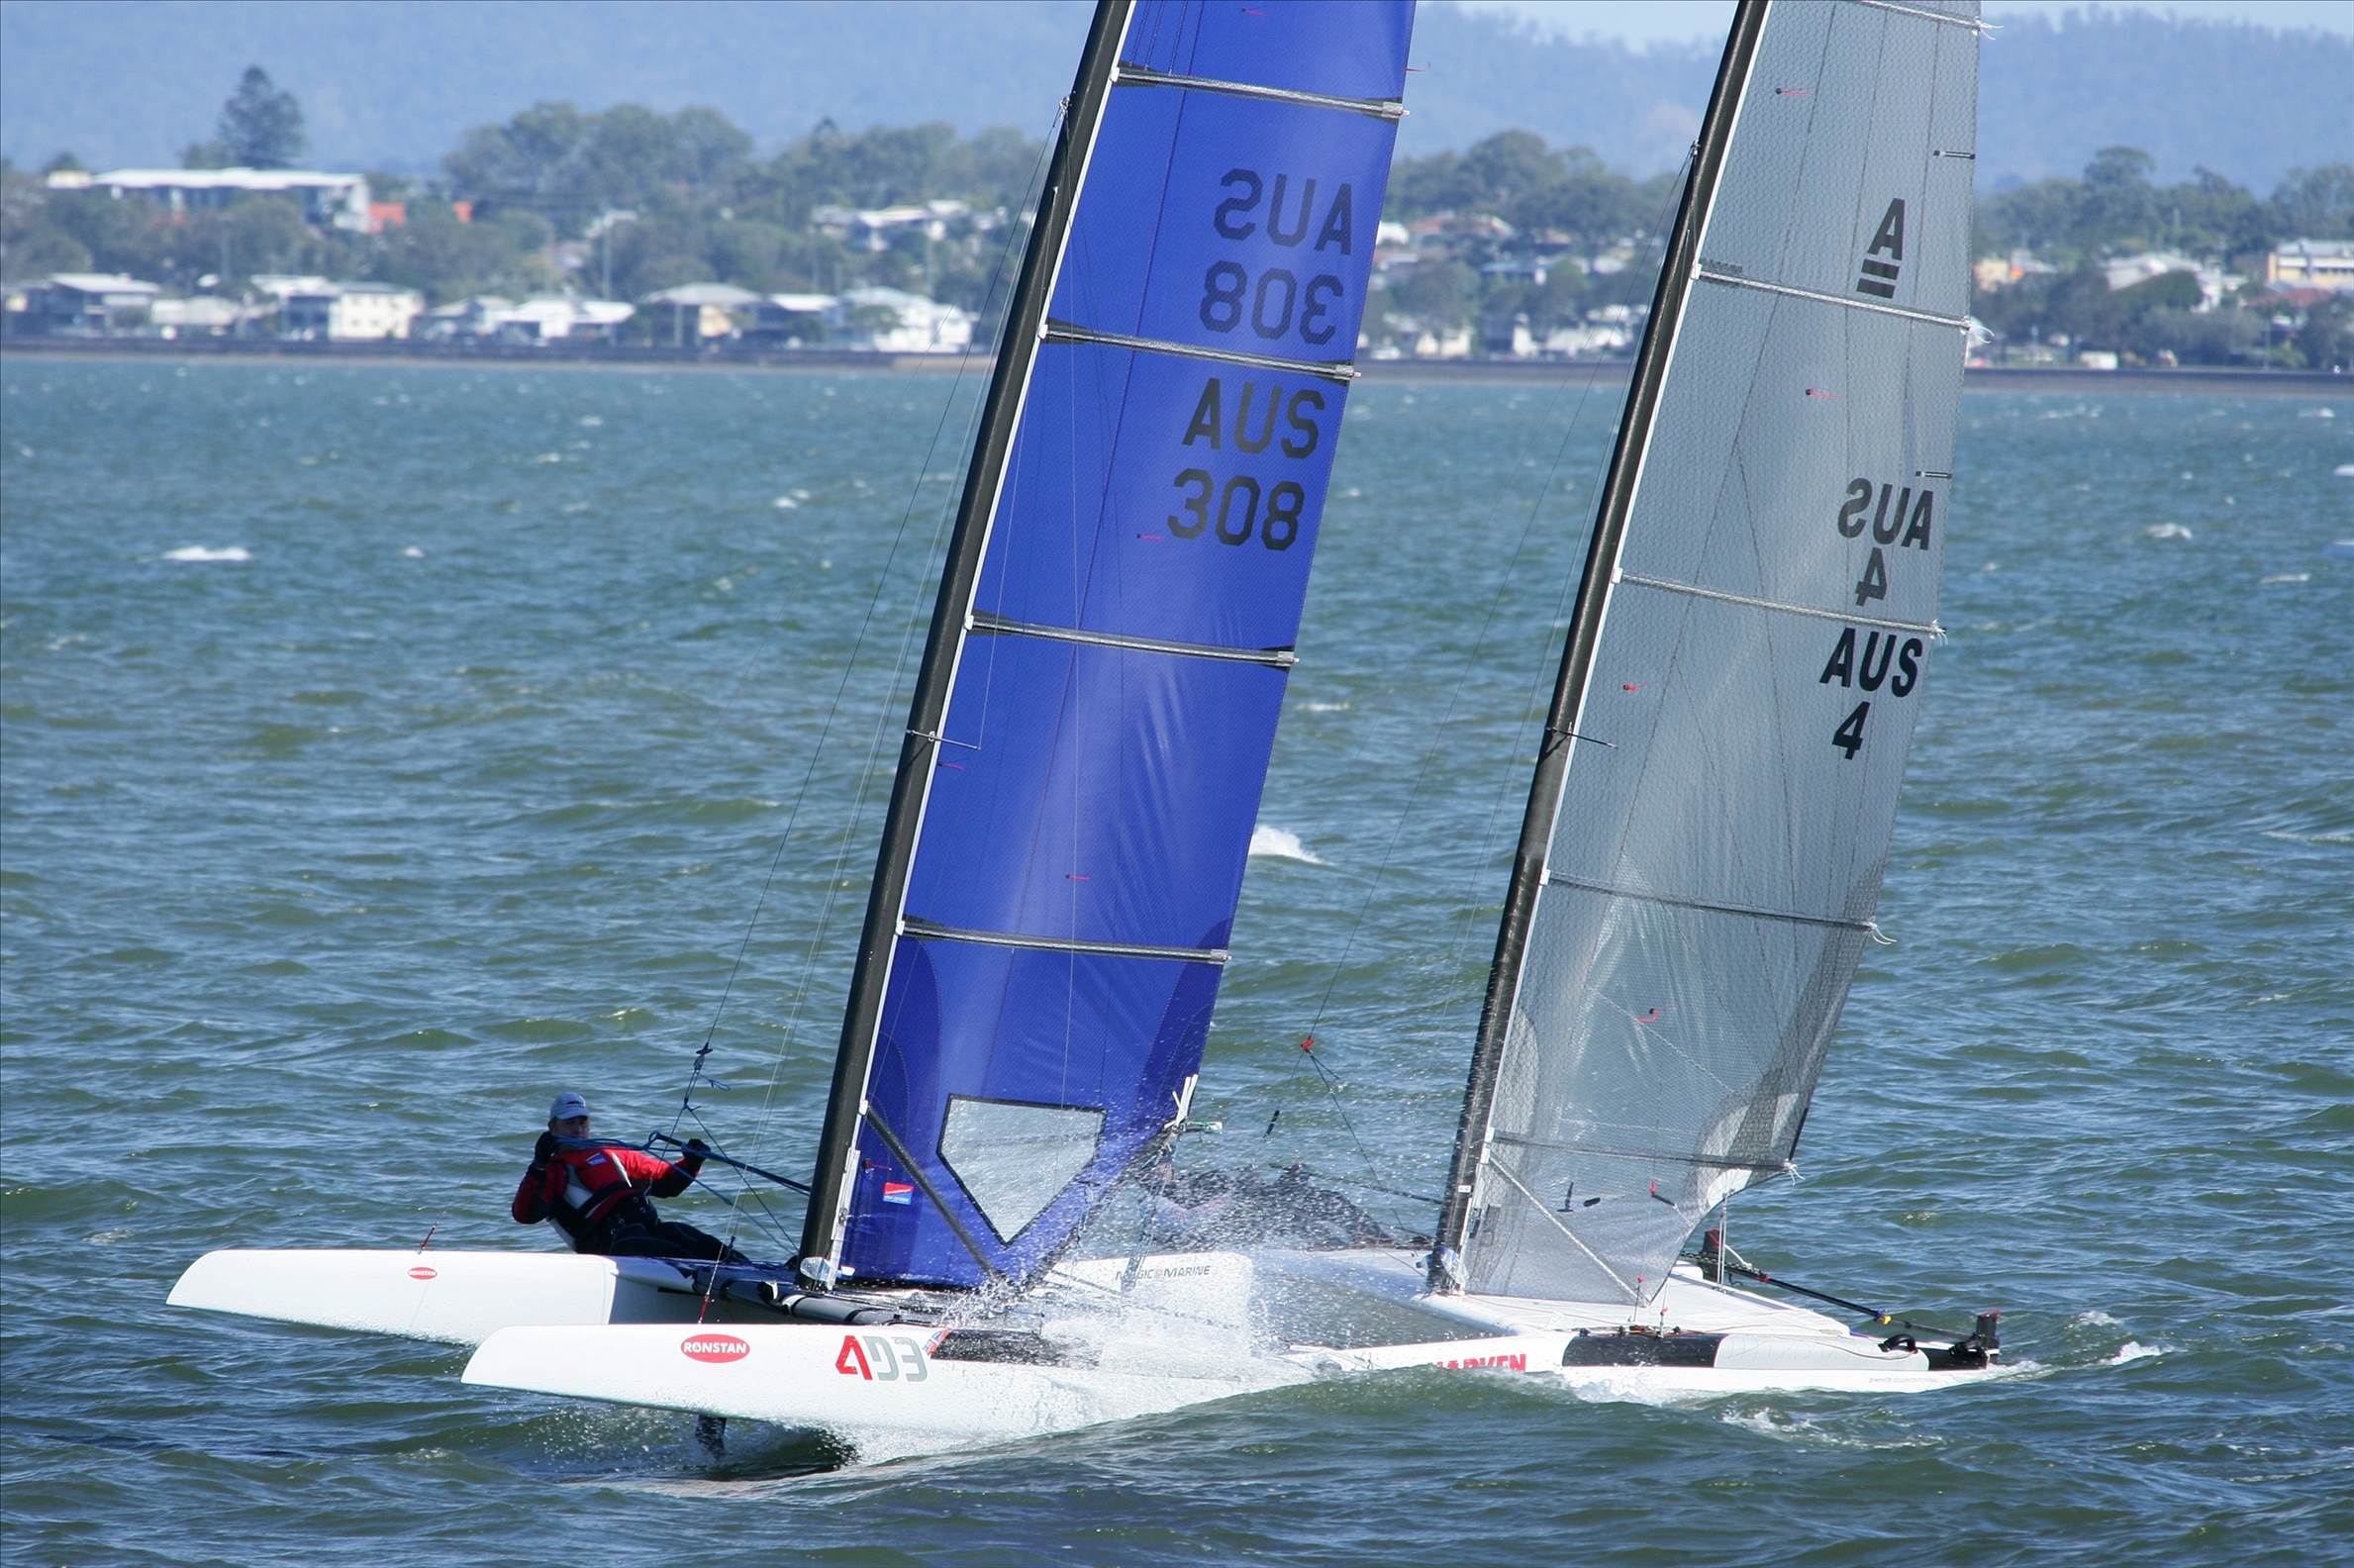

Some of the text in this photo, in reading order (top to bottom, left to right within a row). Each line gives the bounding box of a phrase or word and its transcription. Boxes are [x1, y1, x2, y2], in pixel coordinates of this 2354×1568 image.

[1182, 377, 1325, 459] AUS
[1167, 467, 1305, 551] 308
[1819, 628, 1923, 698] AUS
[1831, 702, 1870, 760] 4
[1116, 1266, 1211, 1280] MGIC MARINE
[683, 1341, 747, 1354] RONSTAN
